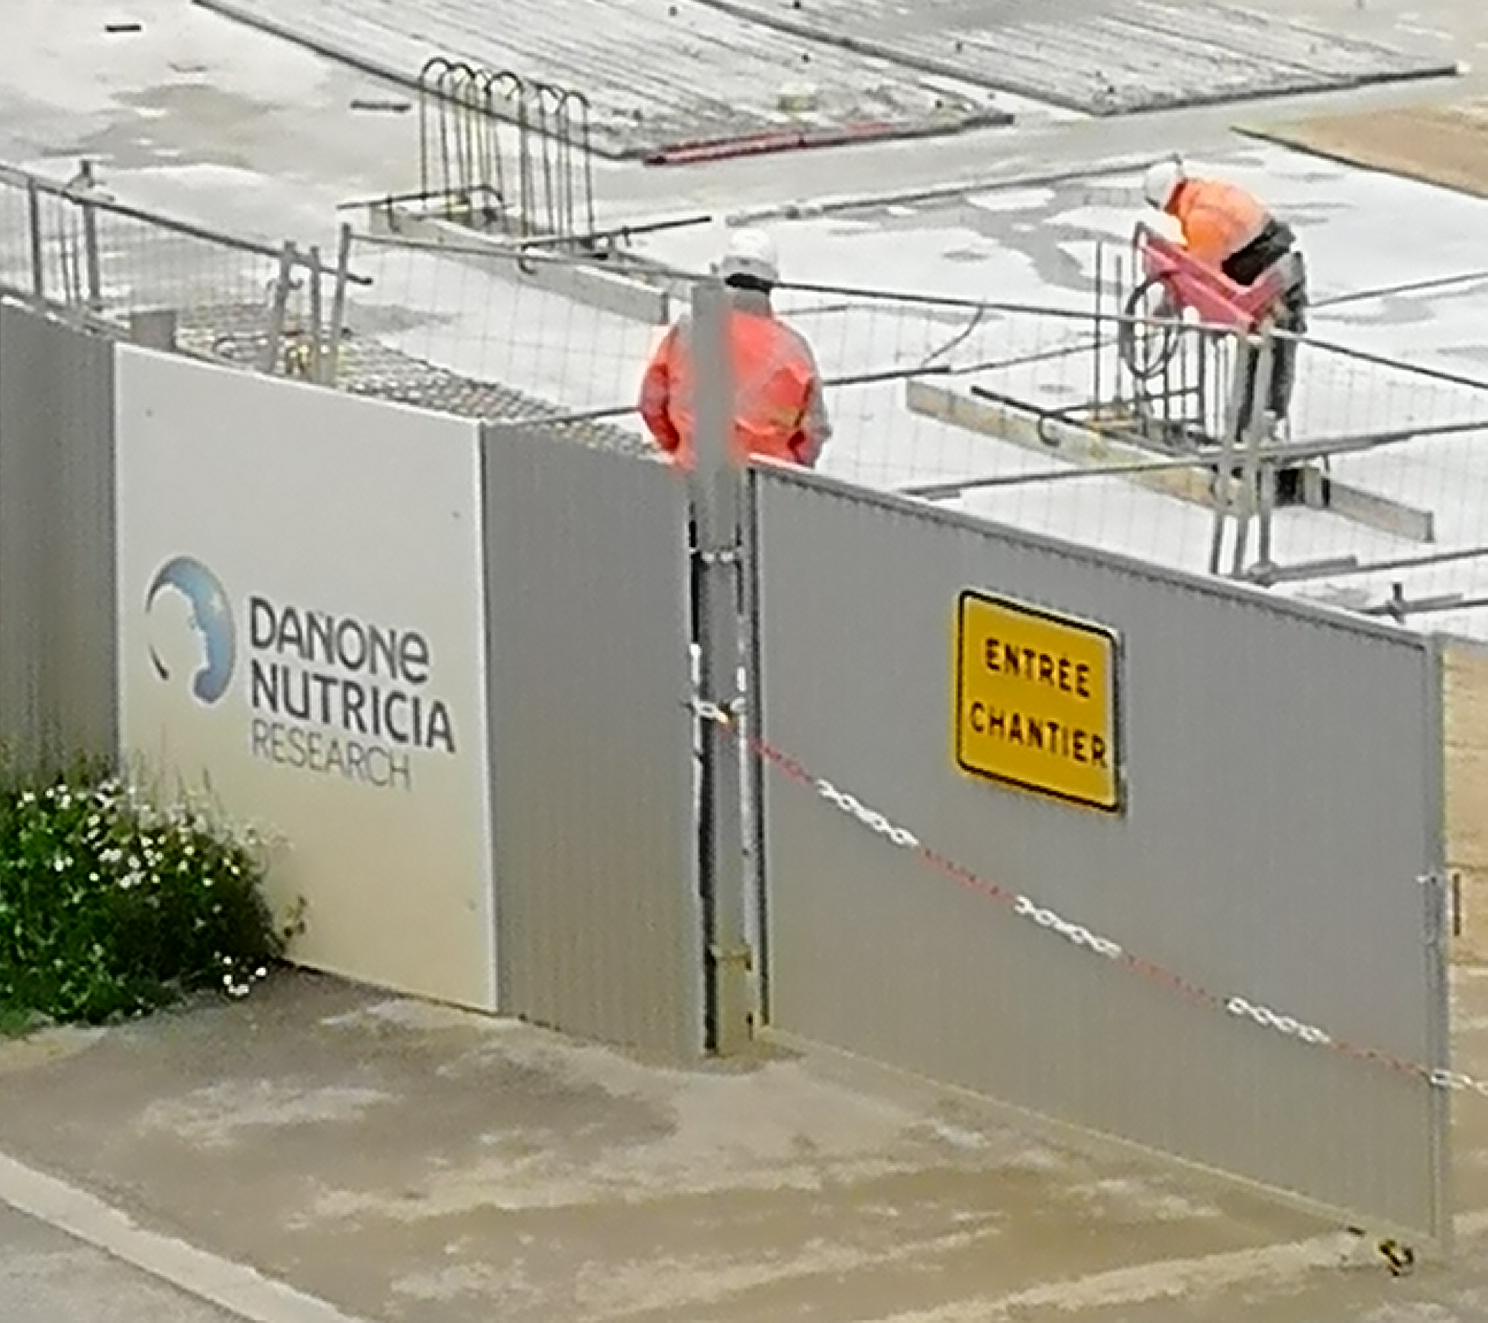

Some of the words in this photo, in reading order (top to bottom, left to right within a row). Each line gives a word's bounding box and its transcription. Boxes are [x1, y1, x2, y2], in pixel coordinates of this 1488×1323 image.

[251, 658, 455, 753] NUTRICIA
[971, 701, 1107, 768] CHANTIER
[252, 718, 410, 790] RESEARCH
